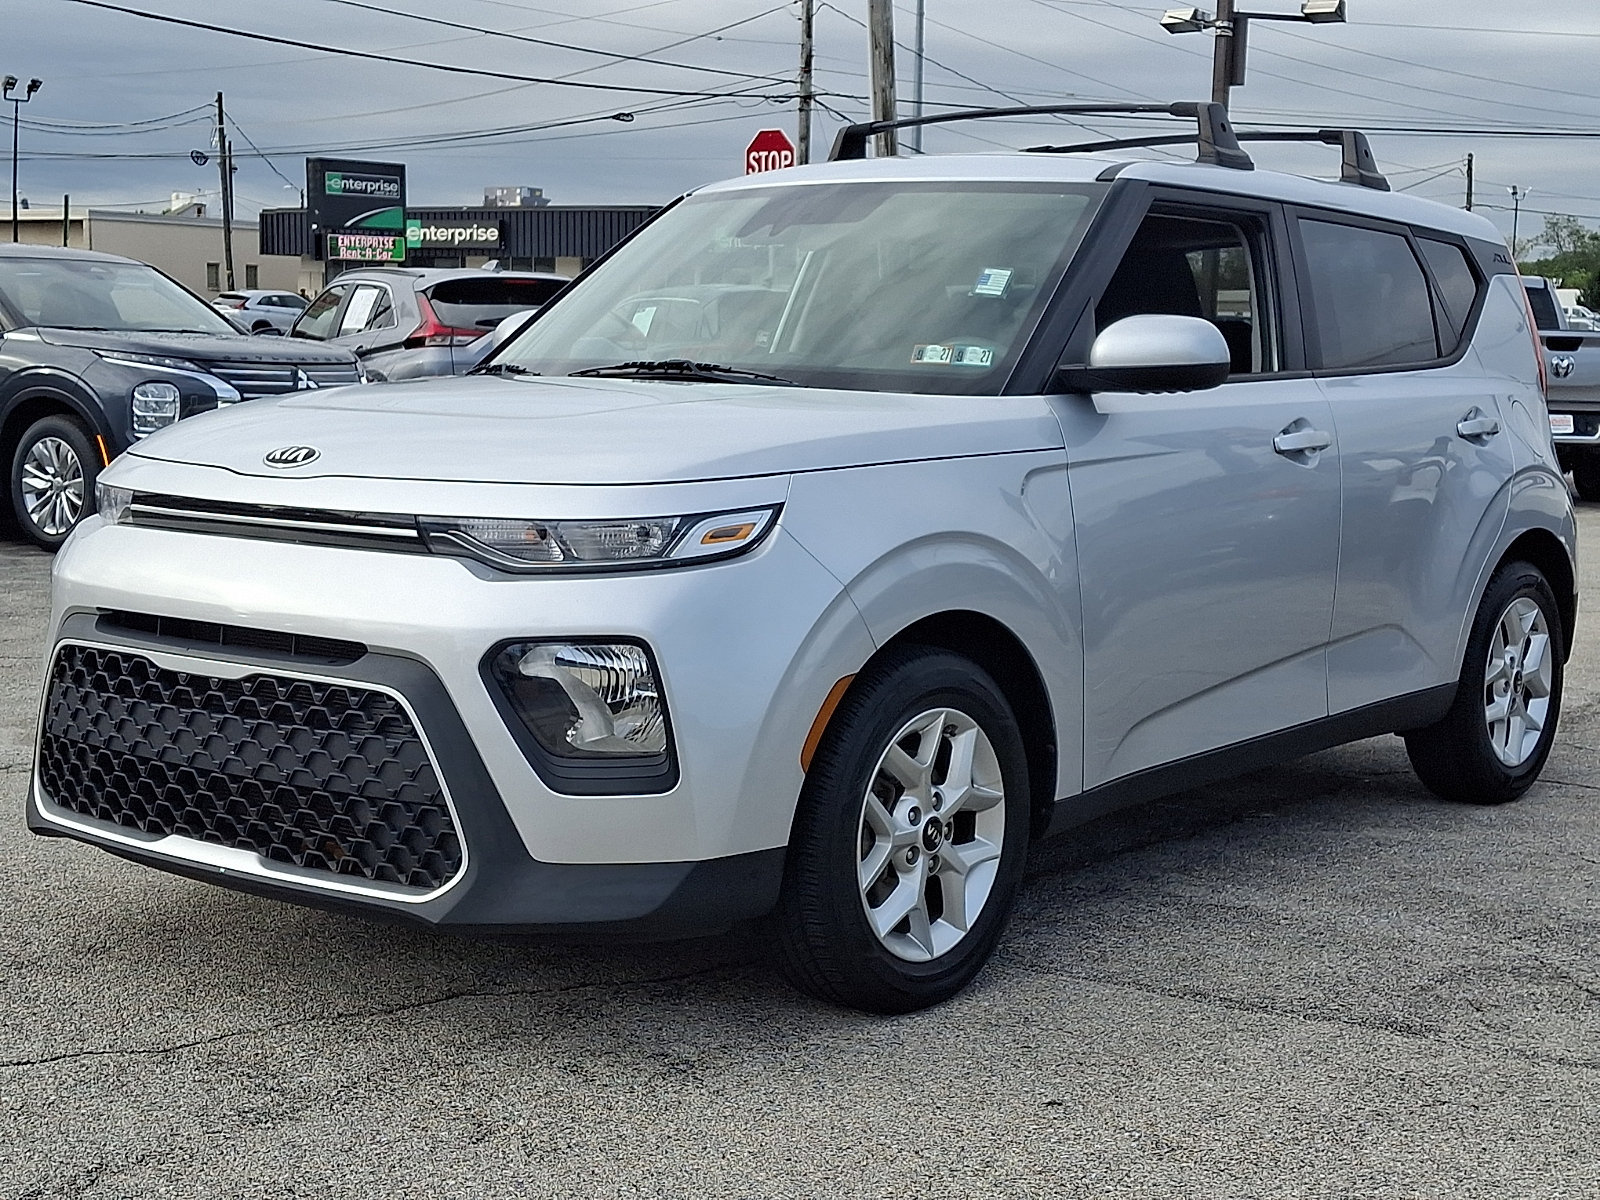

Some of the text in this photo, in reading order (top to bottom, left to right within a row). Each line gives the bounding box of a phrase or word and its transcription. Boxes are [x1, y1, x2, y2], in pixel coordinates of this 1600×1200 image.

[749, 150, 792, 174] STOP
[330, 178, 398, 193] enterprise
[338, 235, 394, 248] ENTERPRISE
[406, 224, 499, 245] enterprise
[340, 246, 393, 260] Rent-A-Car
[940, 348, 950, 361] 27
[980, 350, 990, 363] 27
[266, 446, 314, 463] KIA
